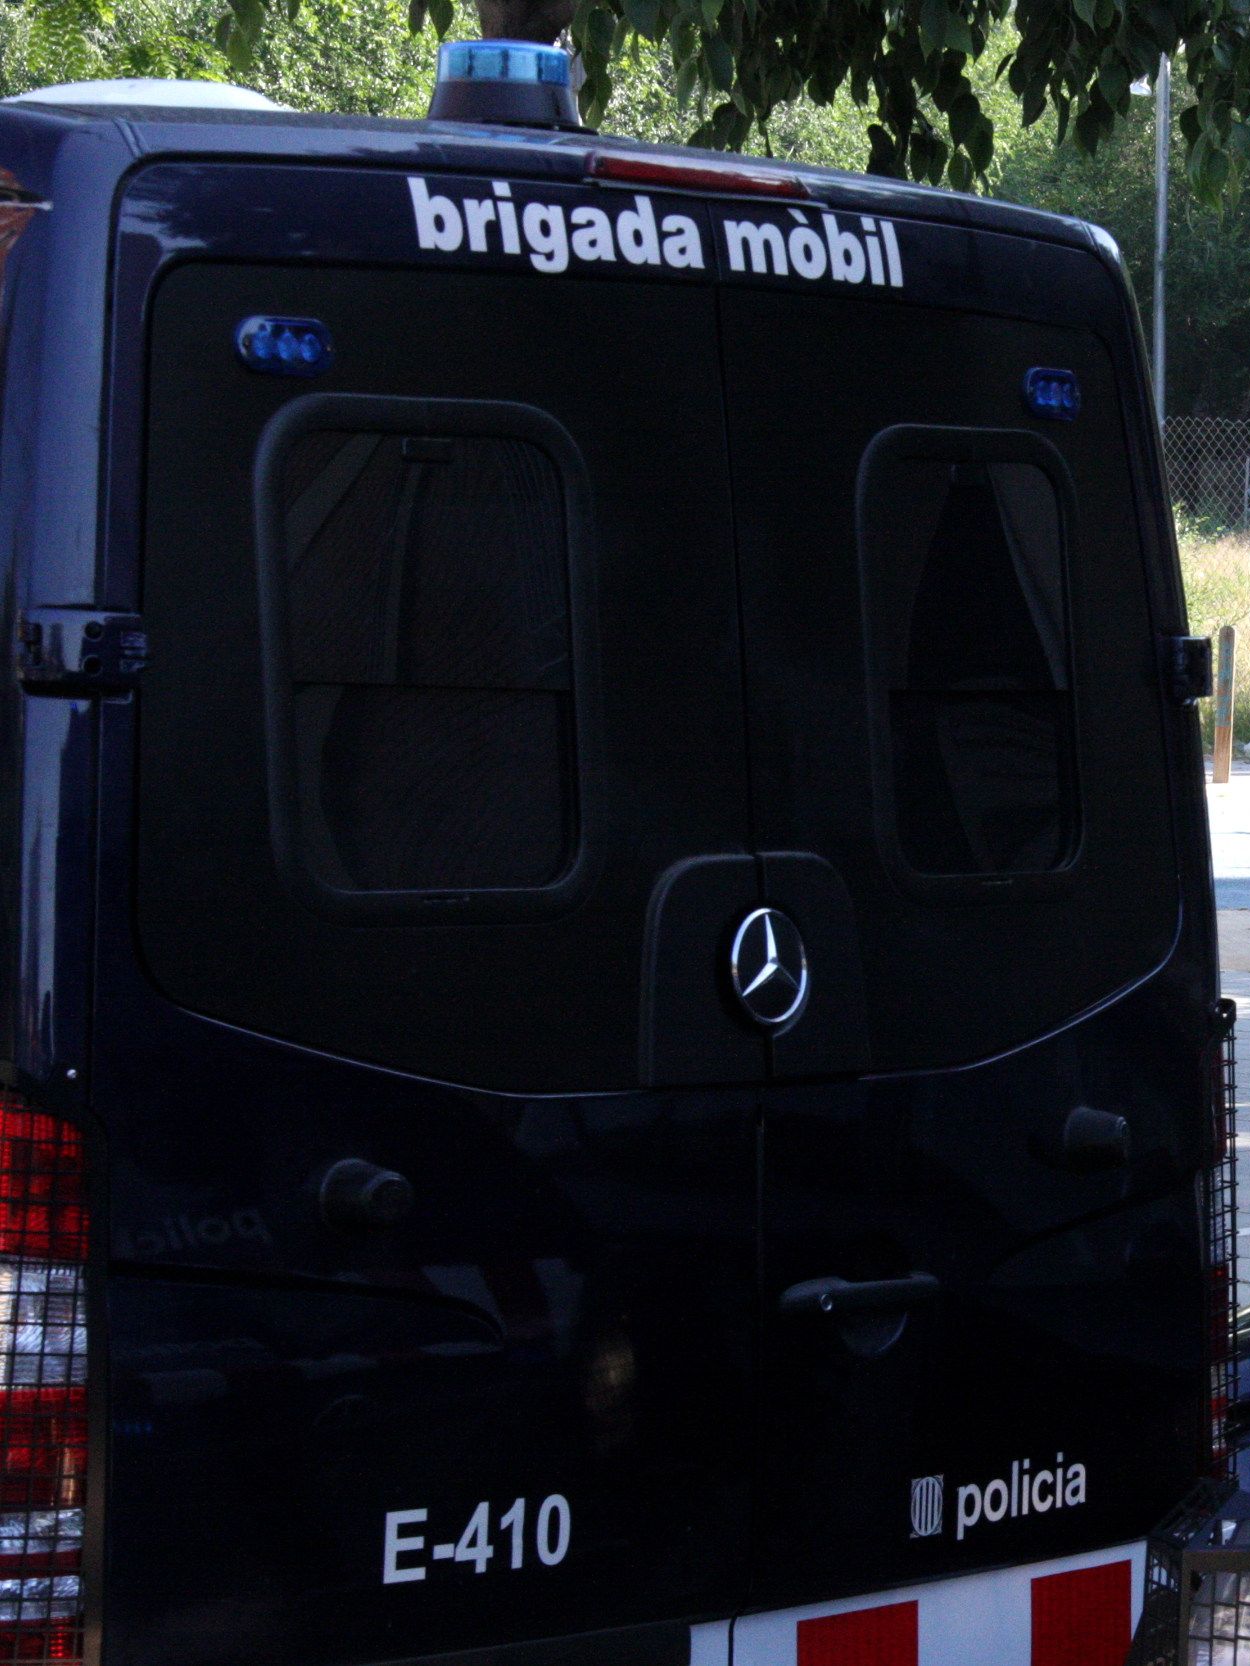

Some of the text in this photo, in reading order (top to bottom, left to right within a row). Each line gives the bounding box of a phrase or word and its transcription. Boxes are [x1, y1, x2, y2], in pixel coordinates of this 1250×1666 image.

[408, 176, 904, 288] brigada mòbil
[383, 1494, 572, 1584] E-410
[956, 1453, 1087, 1540] policia
